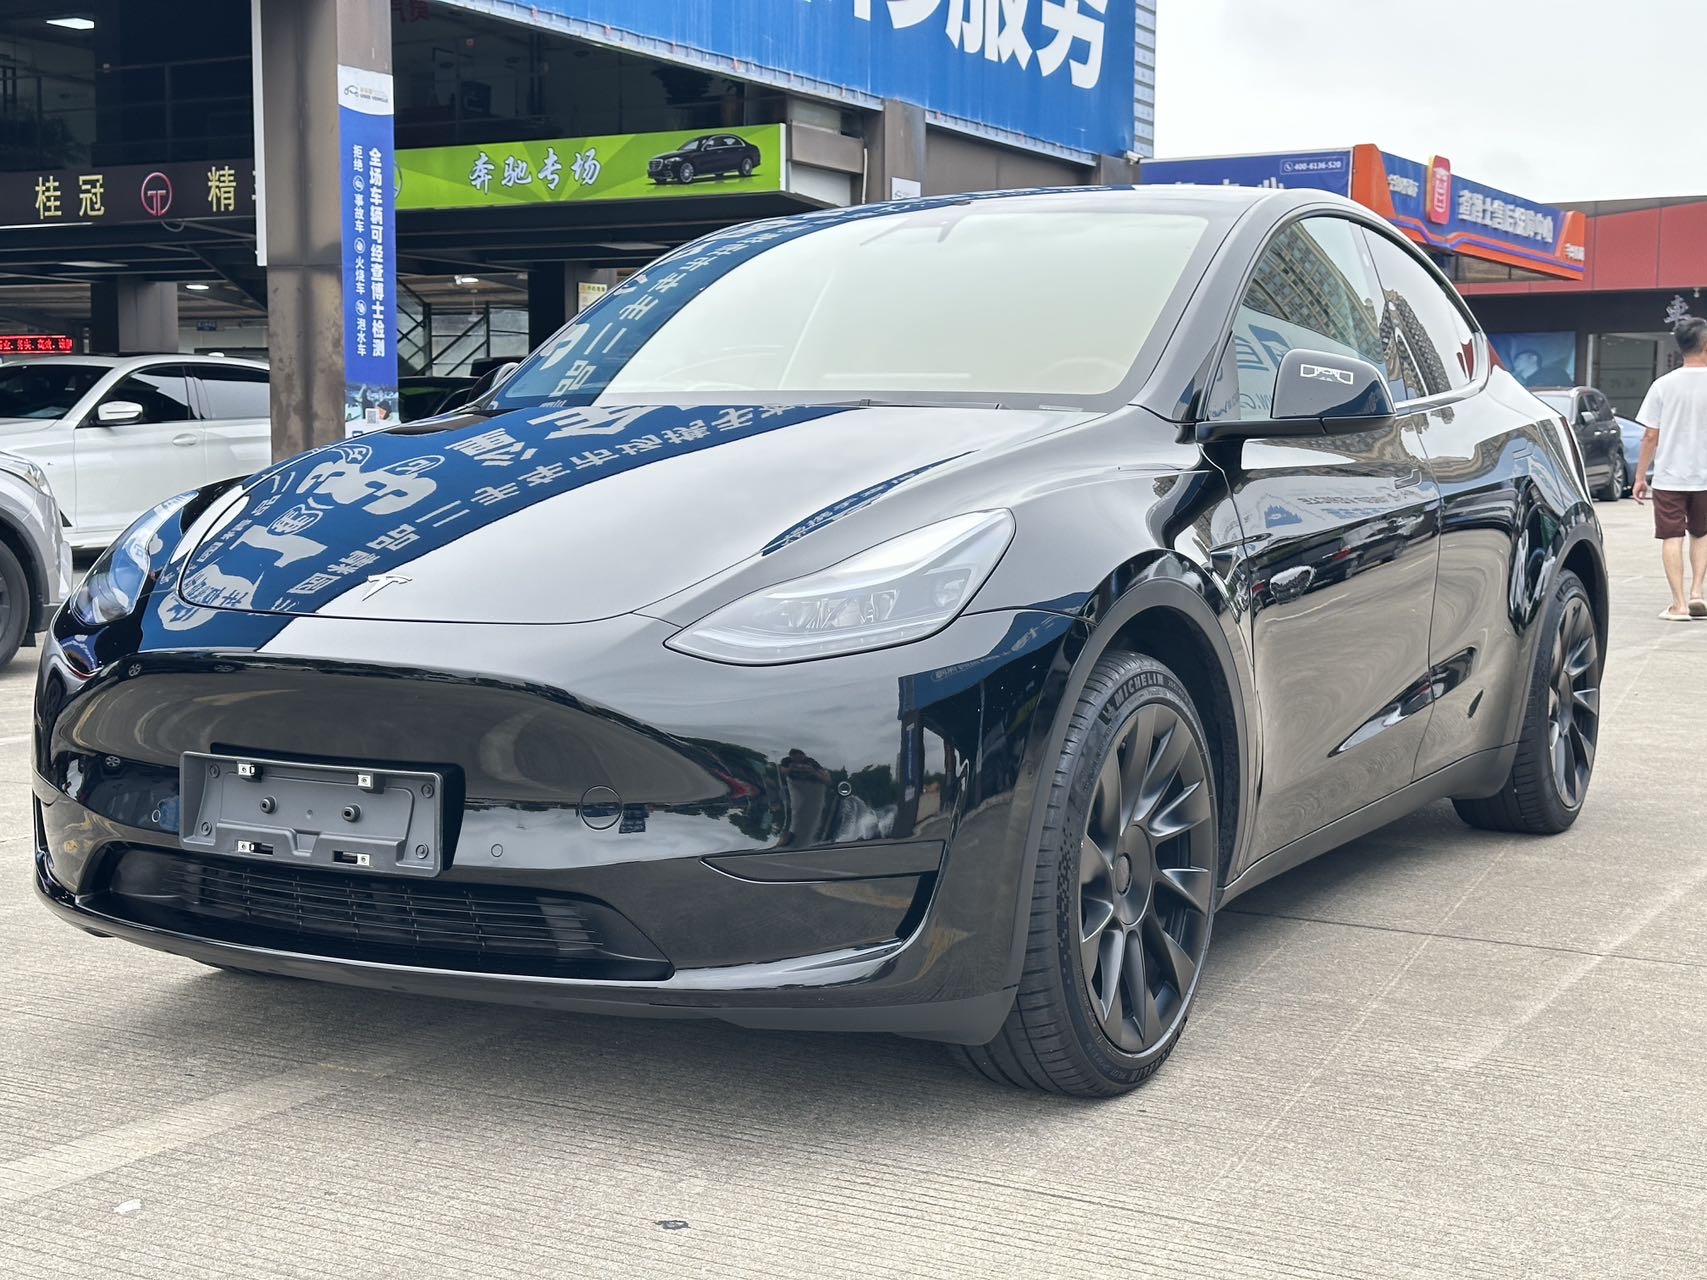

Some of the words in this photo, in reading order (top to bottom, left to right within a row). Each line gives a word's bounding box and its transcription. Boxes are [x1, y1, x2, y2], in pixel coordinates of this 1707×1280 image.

[468, 148, 601, 194] 奔驰专场
[35, 174, 105, 220] 桂冠
[355, 255, 366, 295] 火烧车
[369, 147, 385, 357] 全场车辆可经查博士检测
[1113, 671, 1165, 707] MICHELIN
